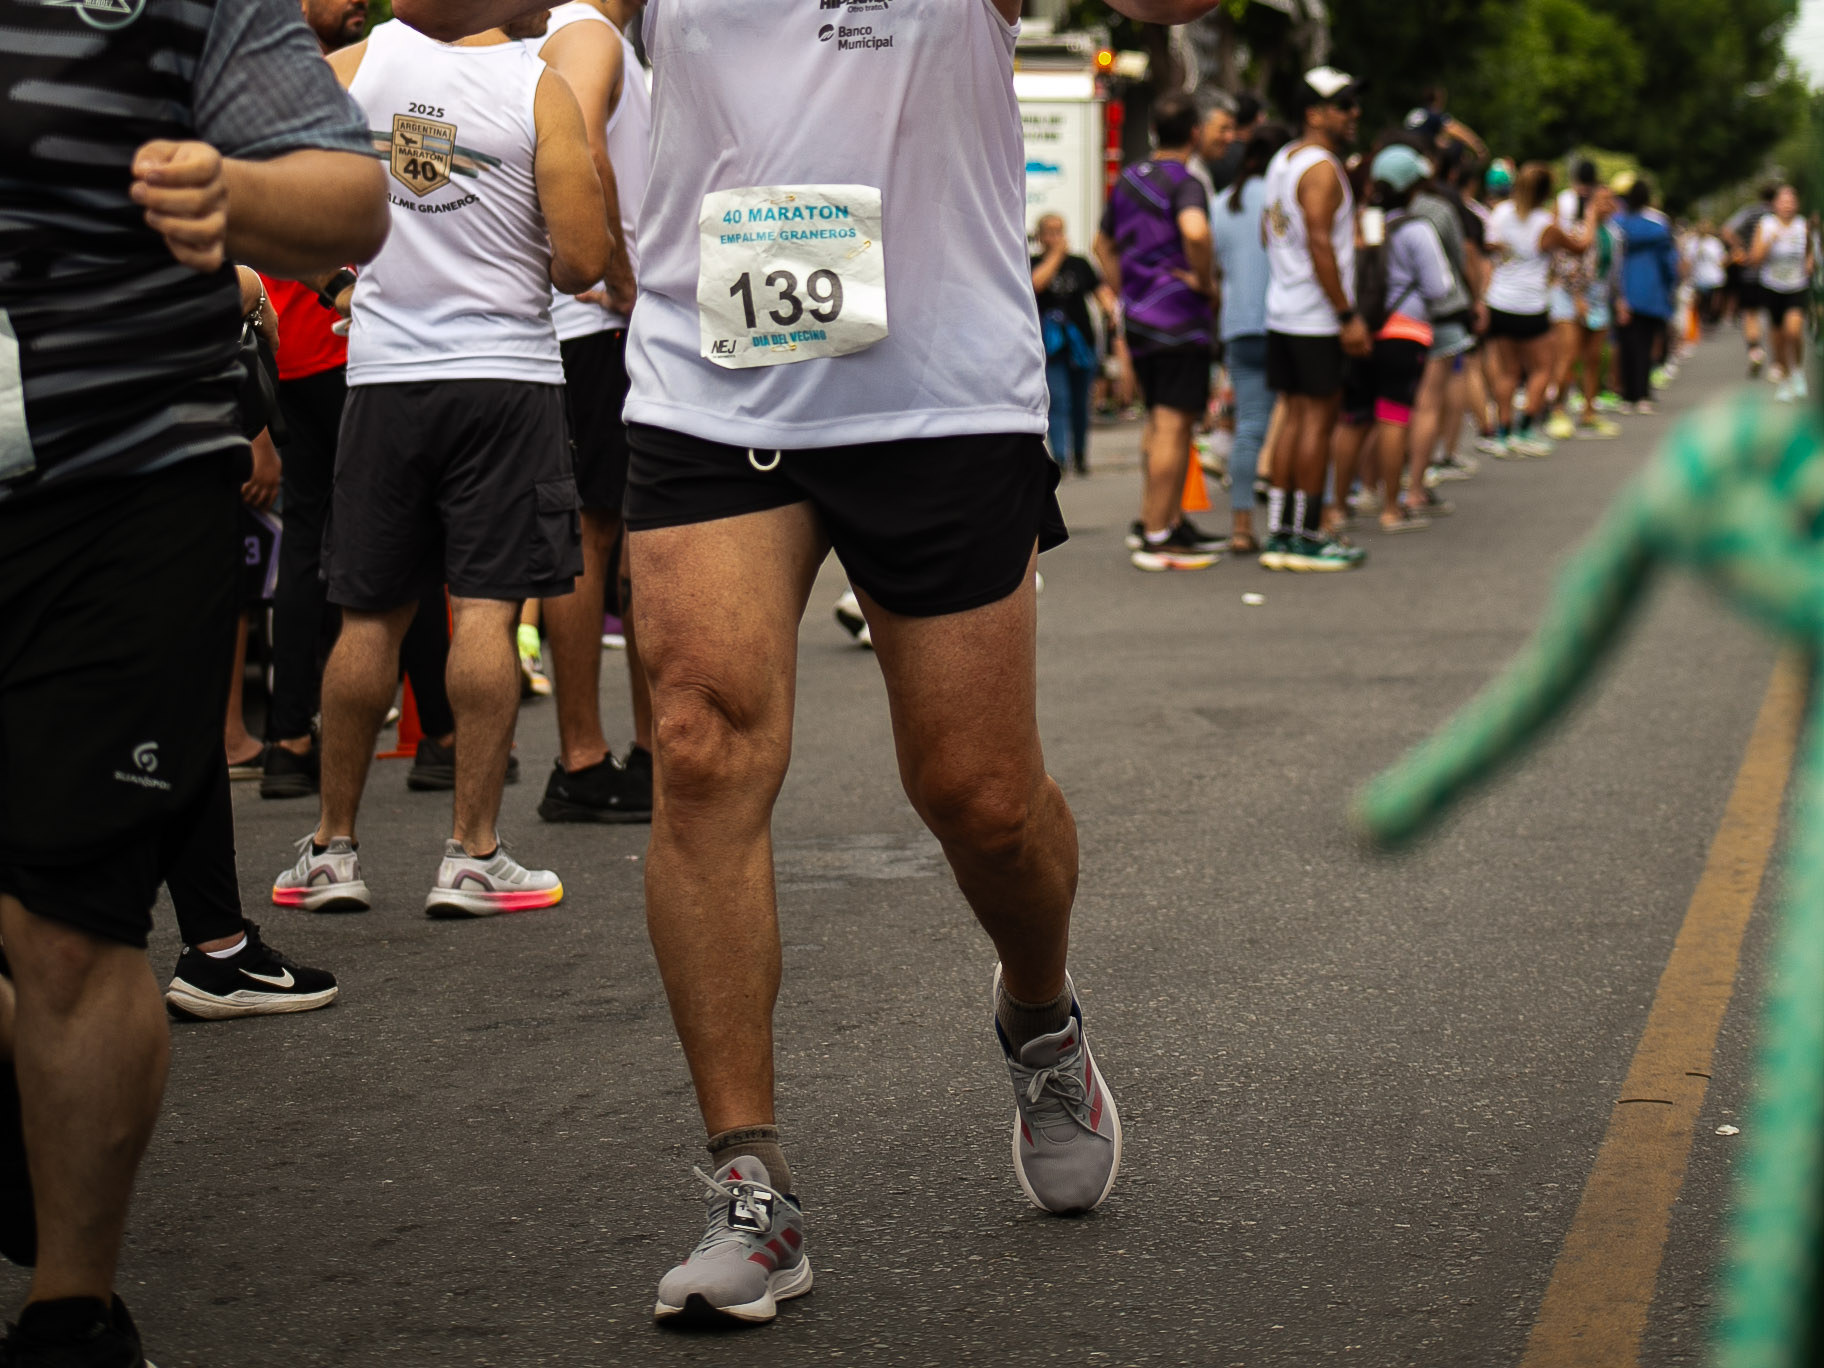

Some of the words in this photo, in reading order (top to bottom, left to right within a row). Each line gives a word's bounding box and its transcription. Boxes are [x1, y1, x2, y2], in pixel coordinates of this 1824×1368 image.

[838, 25, 873, 37] Banco
[837, 36, 894, 51] Municipal
[408, 102, 445, 118] 2025
[400, 121, 449, 138] ARGENTINA
[398, 147, 444, 163] MARATÓN
[403, 158, 438, 182] 40
[723, 209, 743, 225] 40
[748, 205, 849, 223] MARATON
[720, 230, 776, 245] EMPALME
[779, 227, 857, 242] GRANEROS
[729, 268, 844, 329] 139
[711, 339, 737, 355] NEJ
[752, 335, 771, 348] DIA
[771, 333, 789, 346] DEL
[789, 329, 827, 343] VECINO
